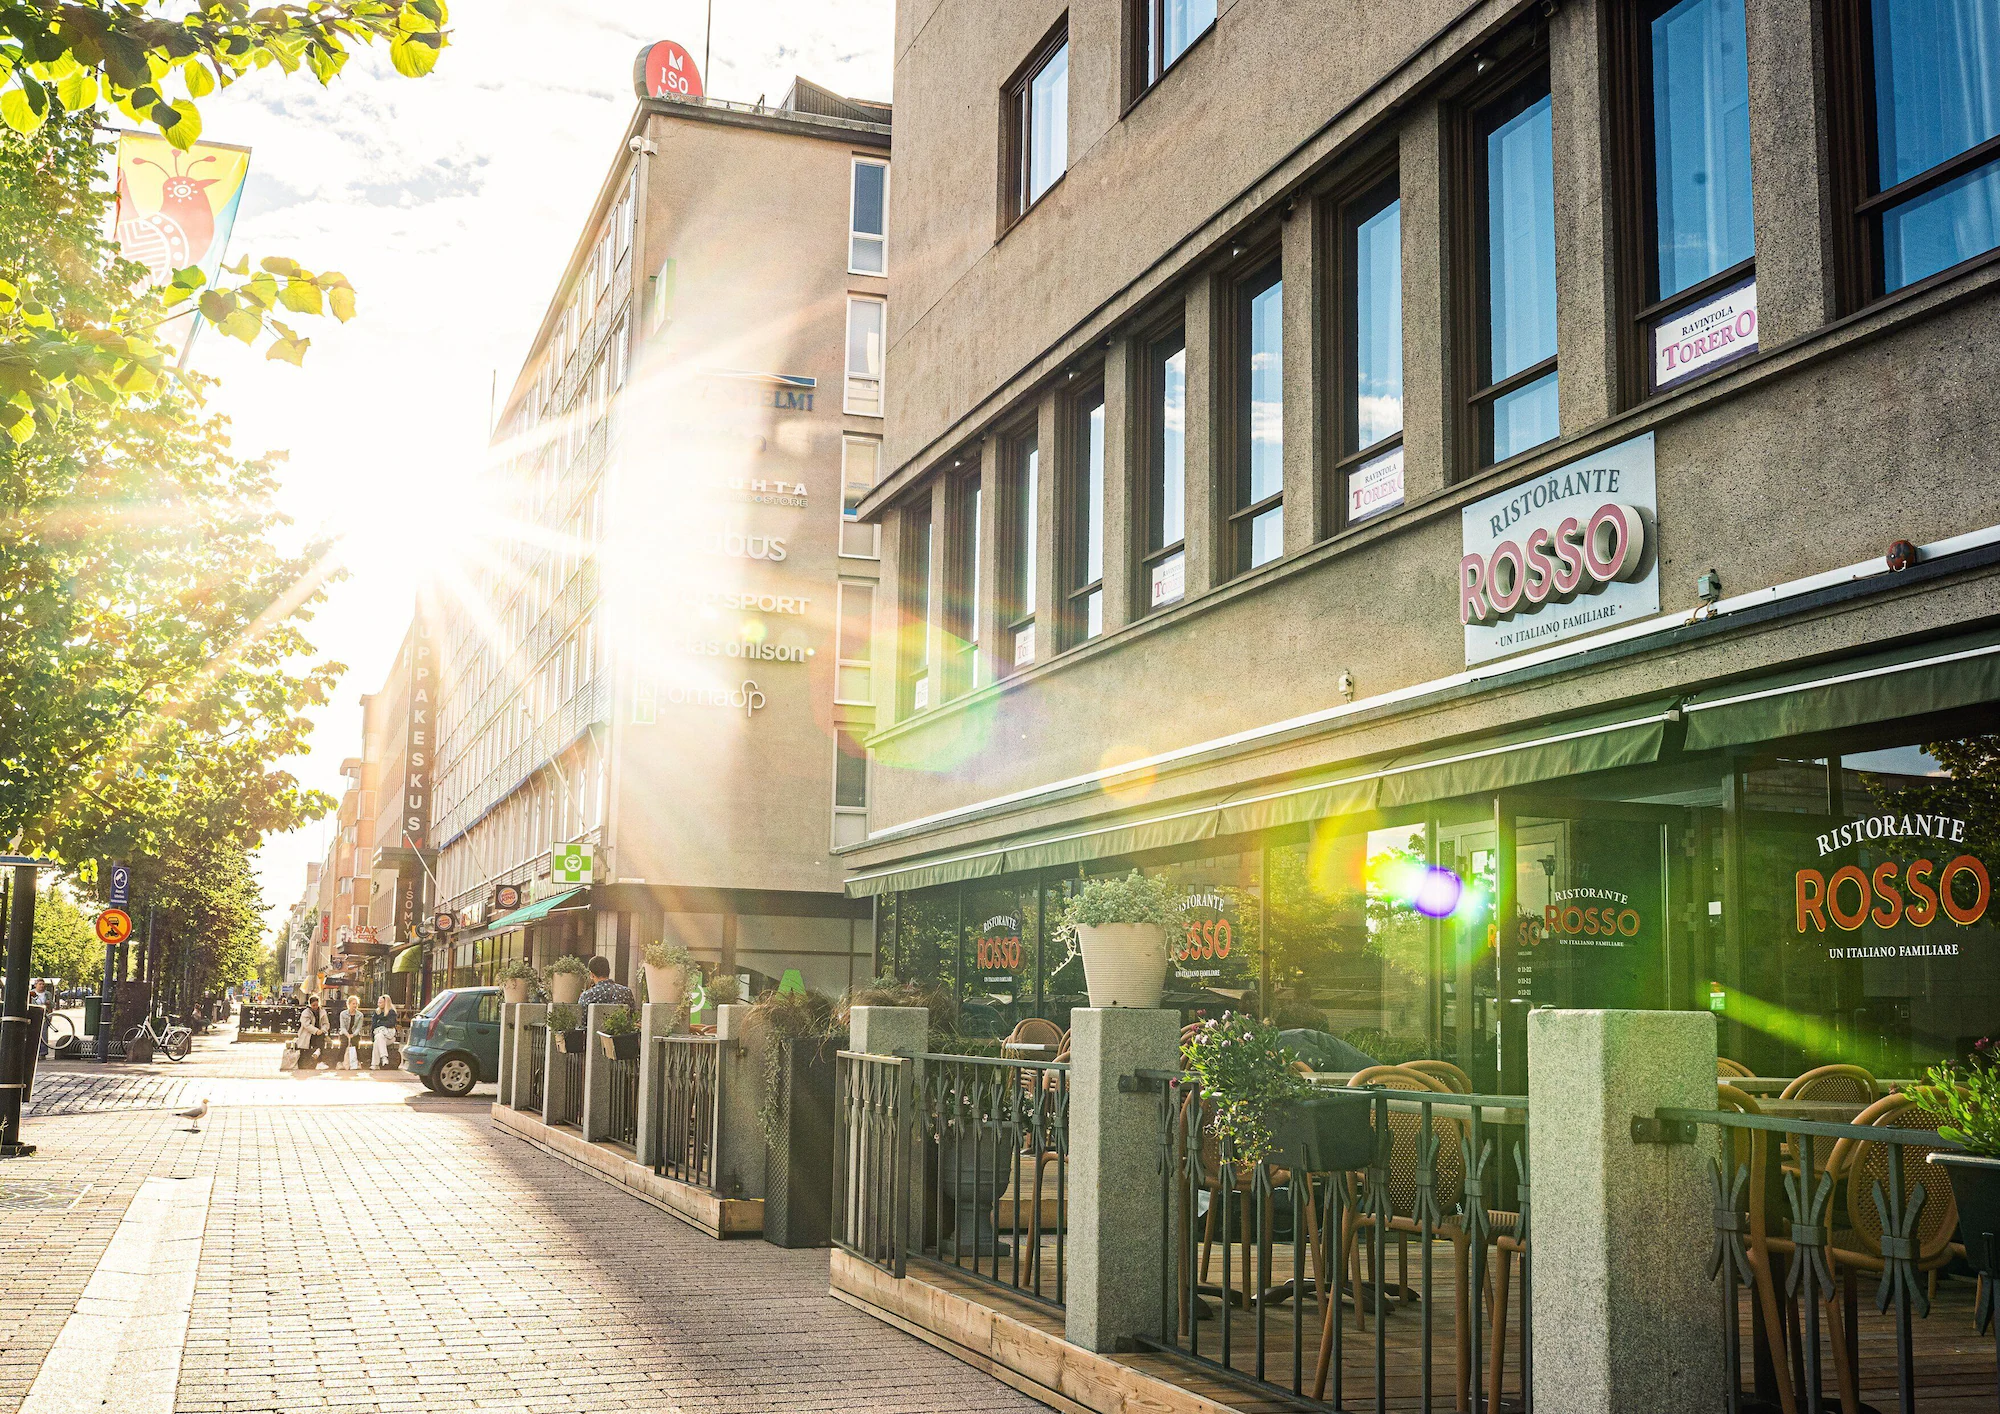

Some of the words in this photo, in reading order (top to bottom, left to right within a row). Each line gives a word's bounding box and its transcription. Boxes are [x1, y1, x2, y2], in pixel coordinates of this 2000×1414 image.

[661, 66, 689, 95] ISO
[1662, 309, 1756, 371] TORERO
[1682, 305, 1734, 336] RAVINTOLA
[711, 475, 808, 496] UHTA
[1490, 469, 1621, 539] RISTORANTE
[684, 519, 788, 562] ubus
[1460, 503, 1634, 625] ROSSO
[1500, 633, 1513, 647] UN
[1516, 621, 1560, 643] ITALIANO
[1563, 605, 1616, 630] FAMILIARE
[408, 602, 434, 831] UPPAKESKUS
[1816, 814, 1966, 857] RISTORANTE
[403, 881, 414, 939] ISOMYY
[1175, 894, 1225, 913] ISTORANTE
[1554, 887, 1629, 905] RISTORANTE
[1796, 855, 1991, 933] ROSSO
[983, 915, 1017, 933] RISTORANTE
[1170, 919, 1231, 961] OSSO
[1544, 905, 1640, 937] ROSSO
[977, 936, 1020, 970] ROSSO
[1829, 948, 1844, 959] UN
[1847, 946, 1896, 959] ITALIANO
[1899, 944, 1959, 957] FAMILIARE
